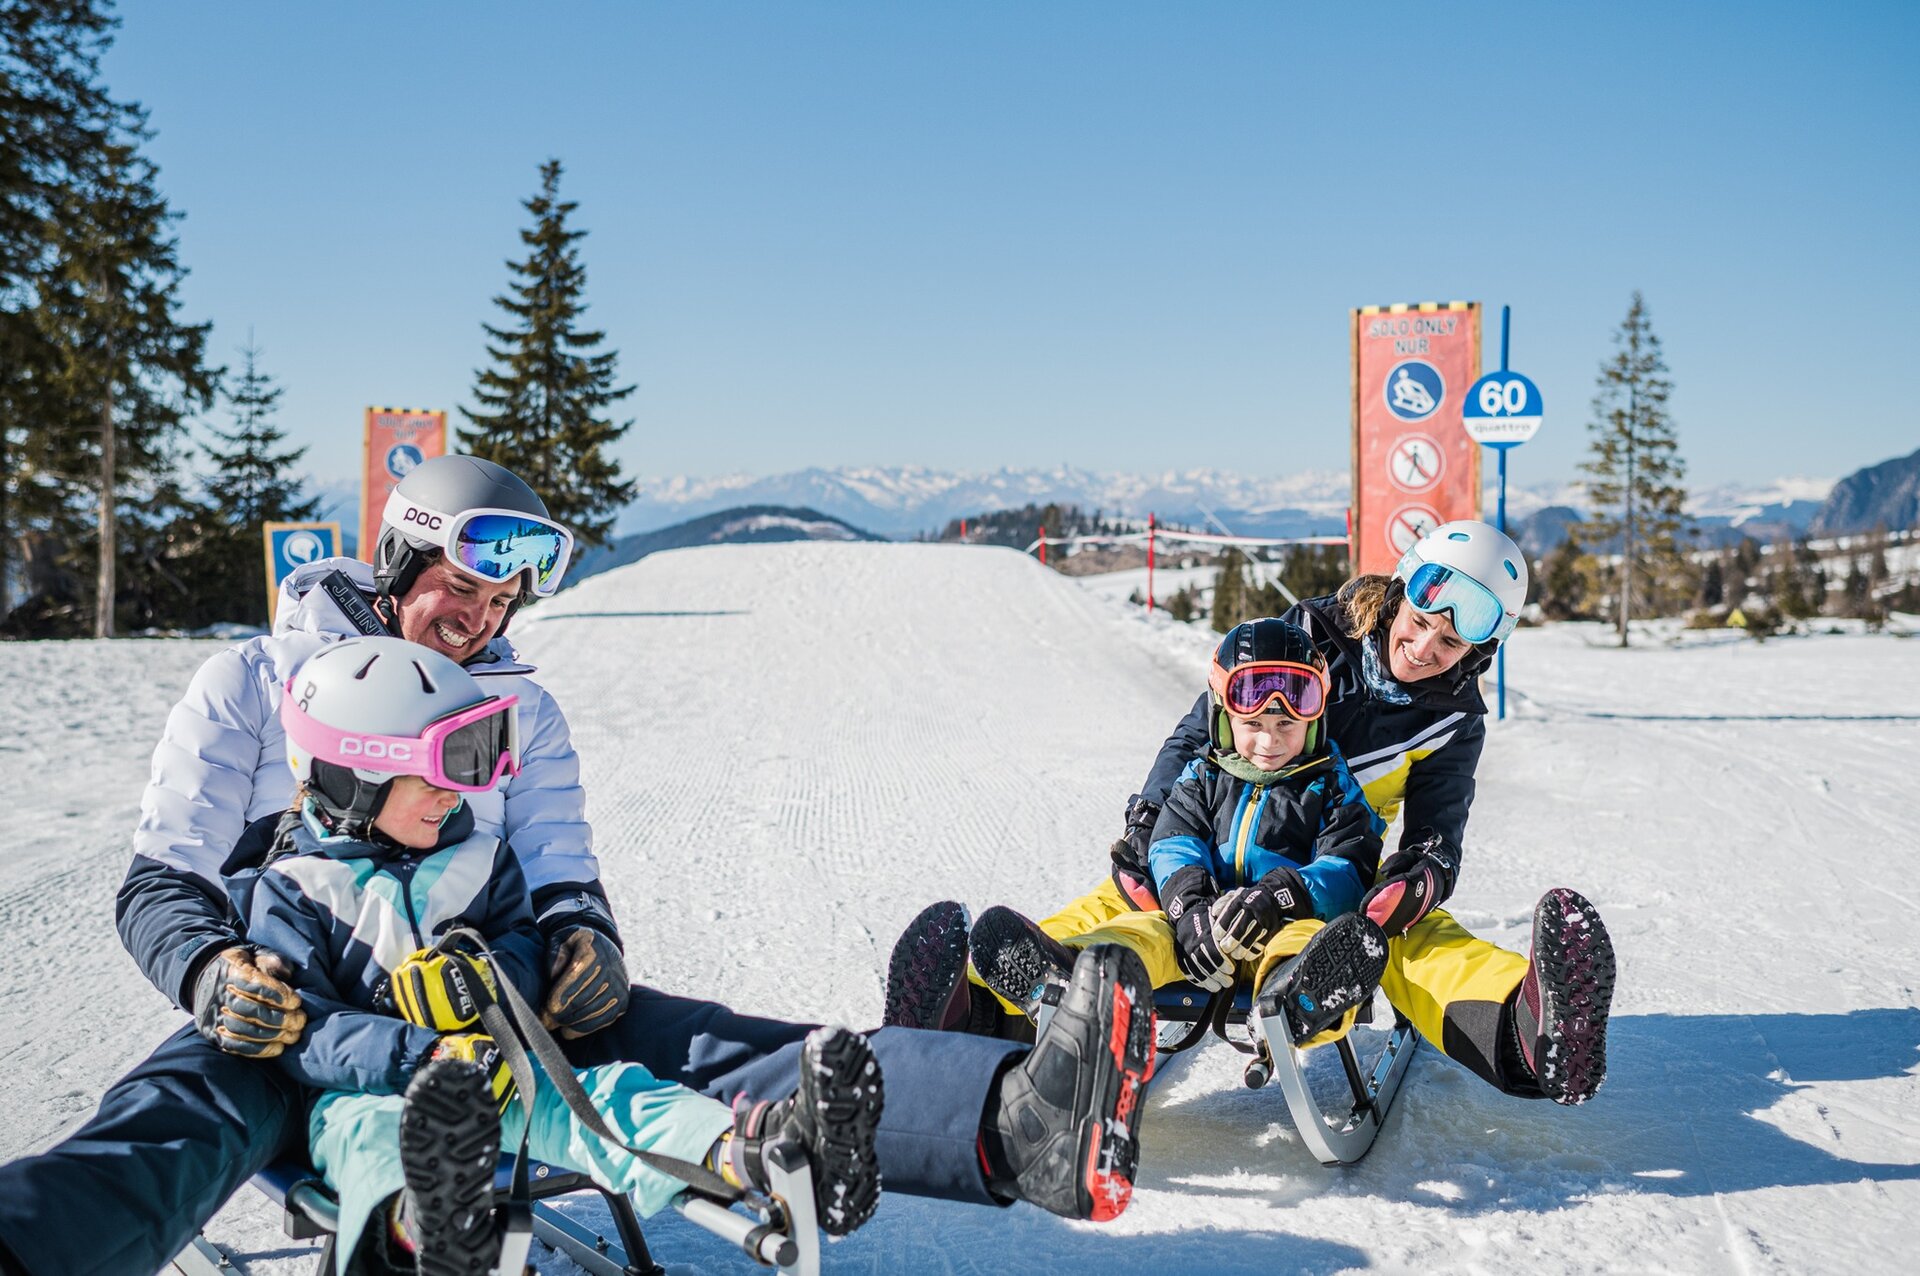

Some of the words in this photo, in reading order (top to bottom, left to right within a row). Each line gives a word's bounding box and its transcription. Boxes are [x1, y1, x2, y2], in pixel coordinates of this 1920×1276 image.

[1370, 317, 1410, 338] SOLO
[1412, 315, 1457, 337] ONLY
[1394, 337, 1430, 356] NUR
[1479, 379, 1527, 416] 60
[450, 967, 474, 1015] LEVEL
[477, 1047, 500, 1071] VEL
